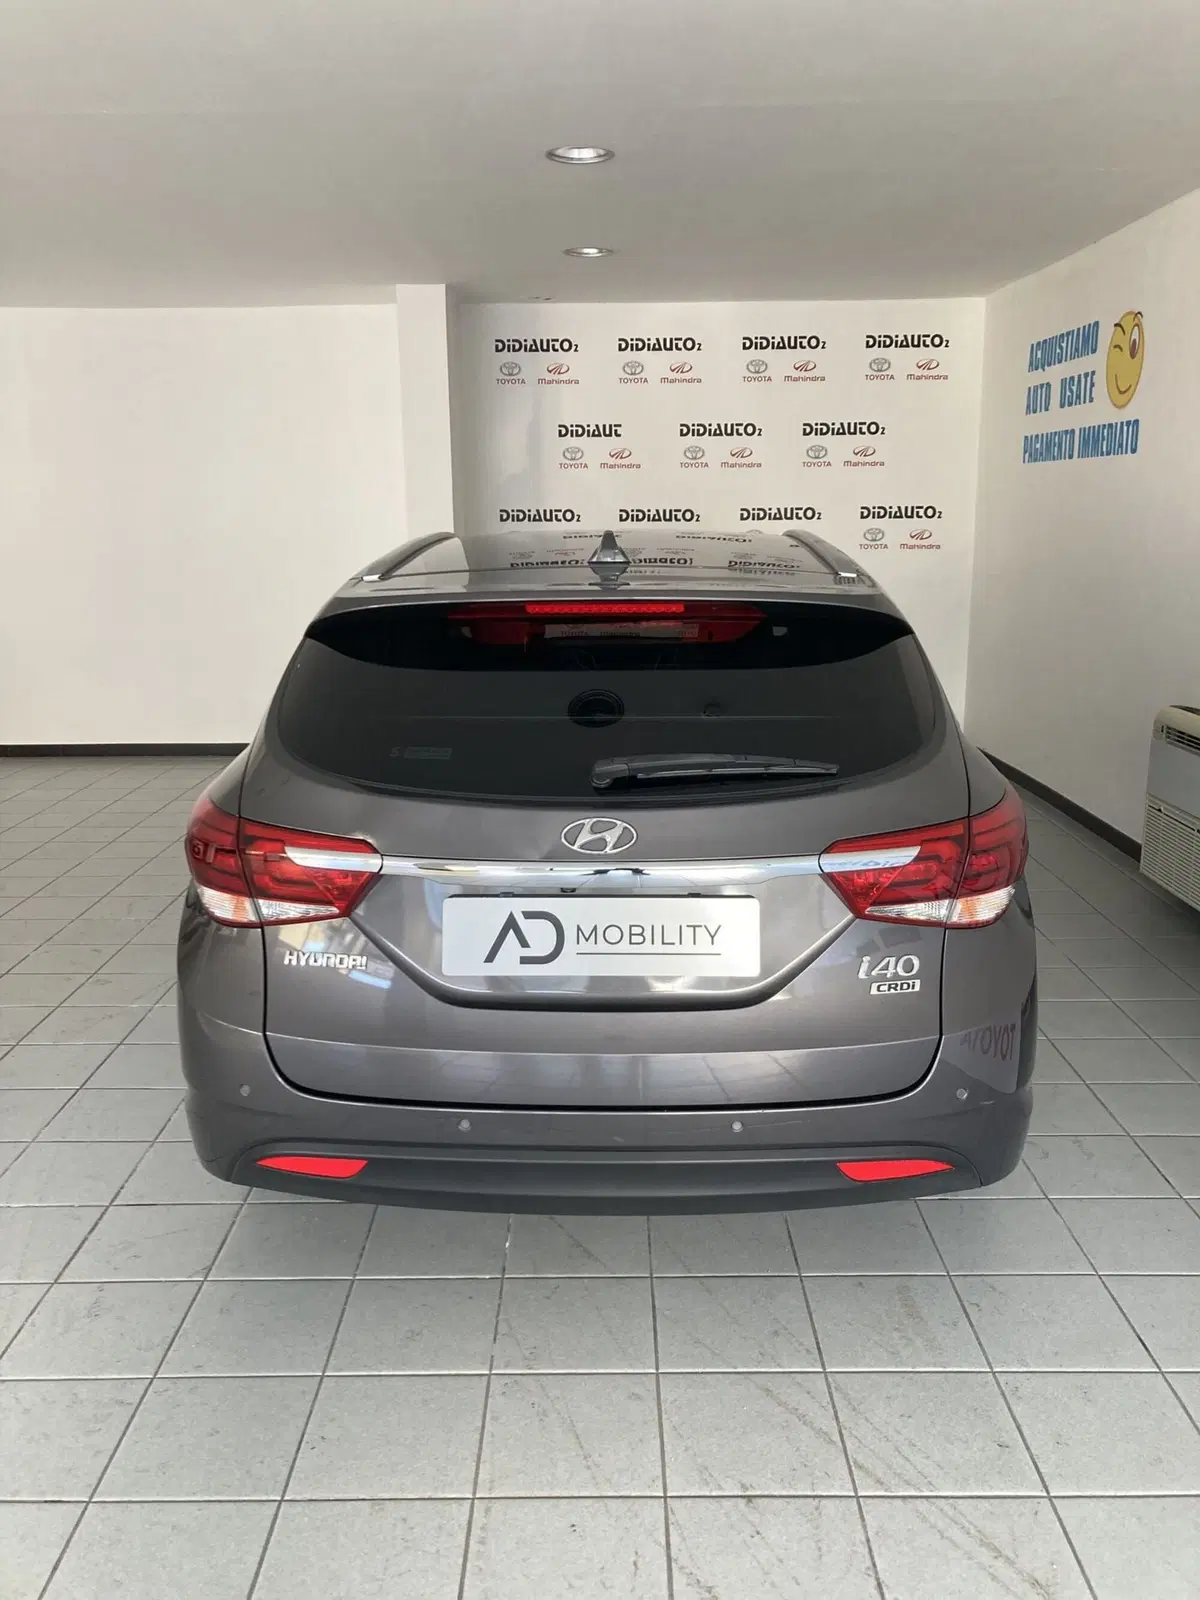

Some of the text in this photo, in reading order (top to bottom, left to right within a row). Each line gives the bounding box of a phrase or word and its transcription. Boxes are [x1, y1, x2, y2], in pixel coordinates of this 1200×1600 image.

[1028, 320, 1100, 372] ACQUISTIAMO
[1026, 370, 1096, 415] AUTO USATE
[1023, 418, 1140, 464] PAGAMENTO IMMEDIATO
[576, 924, 722, 946] MOBILITY
[284, 950, 368, 970] HYUNDAI
[858, 954, 920, 979] i40
[876, 980, 916, 993] CRDi
